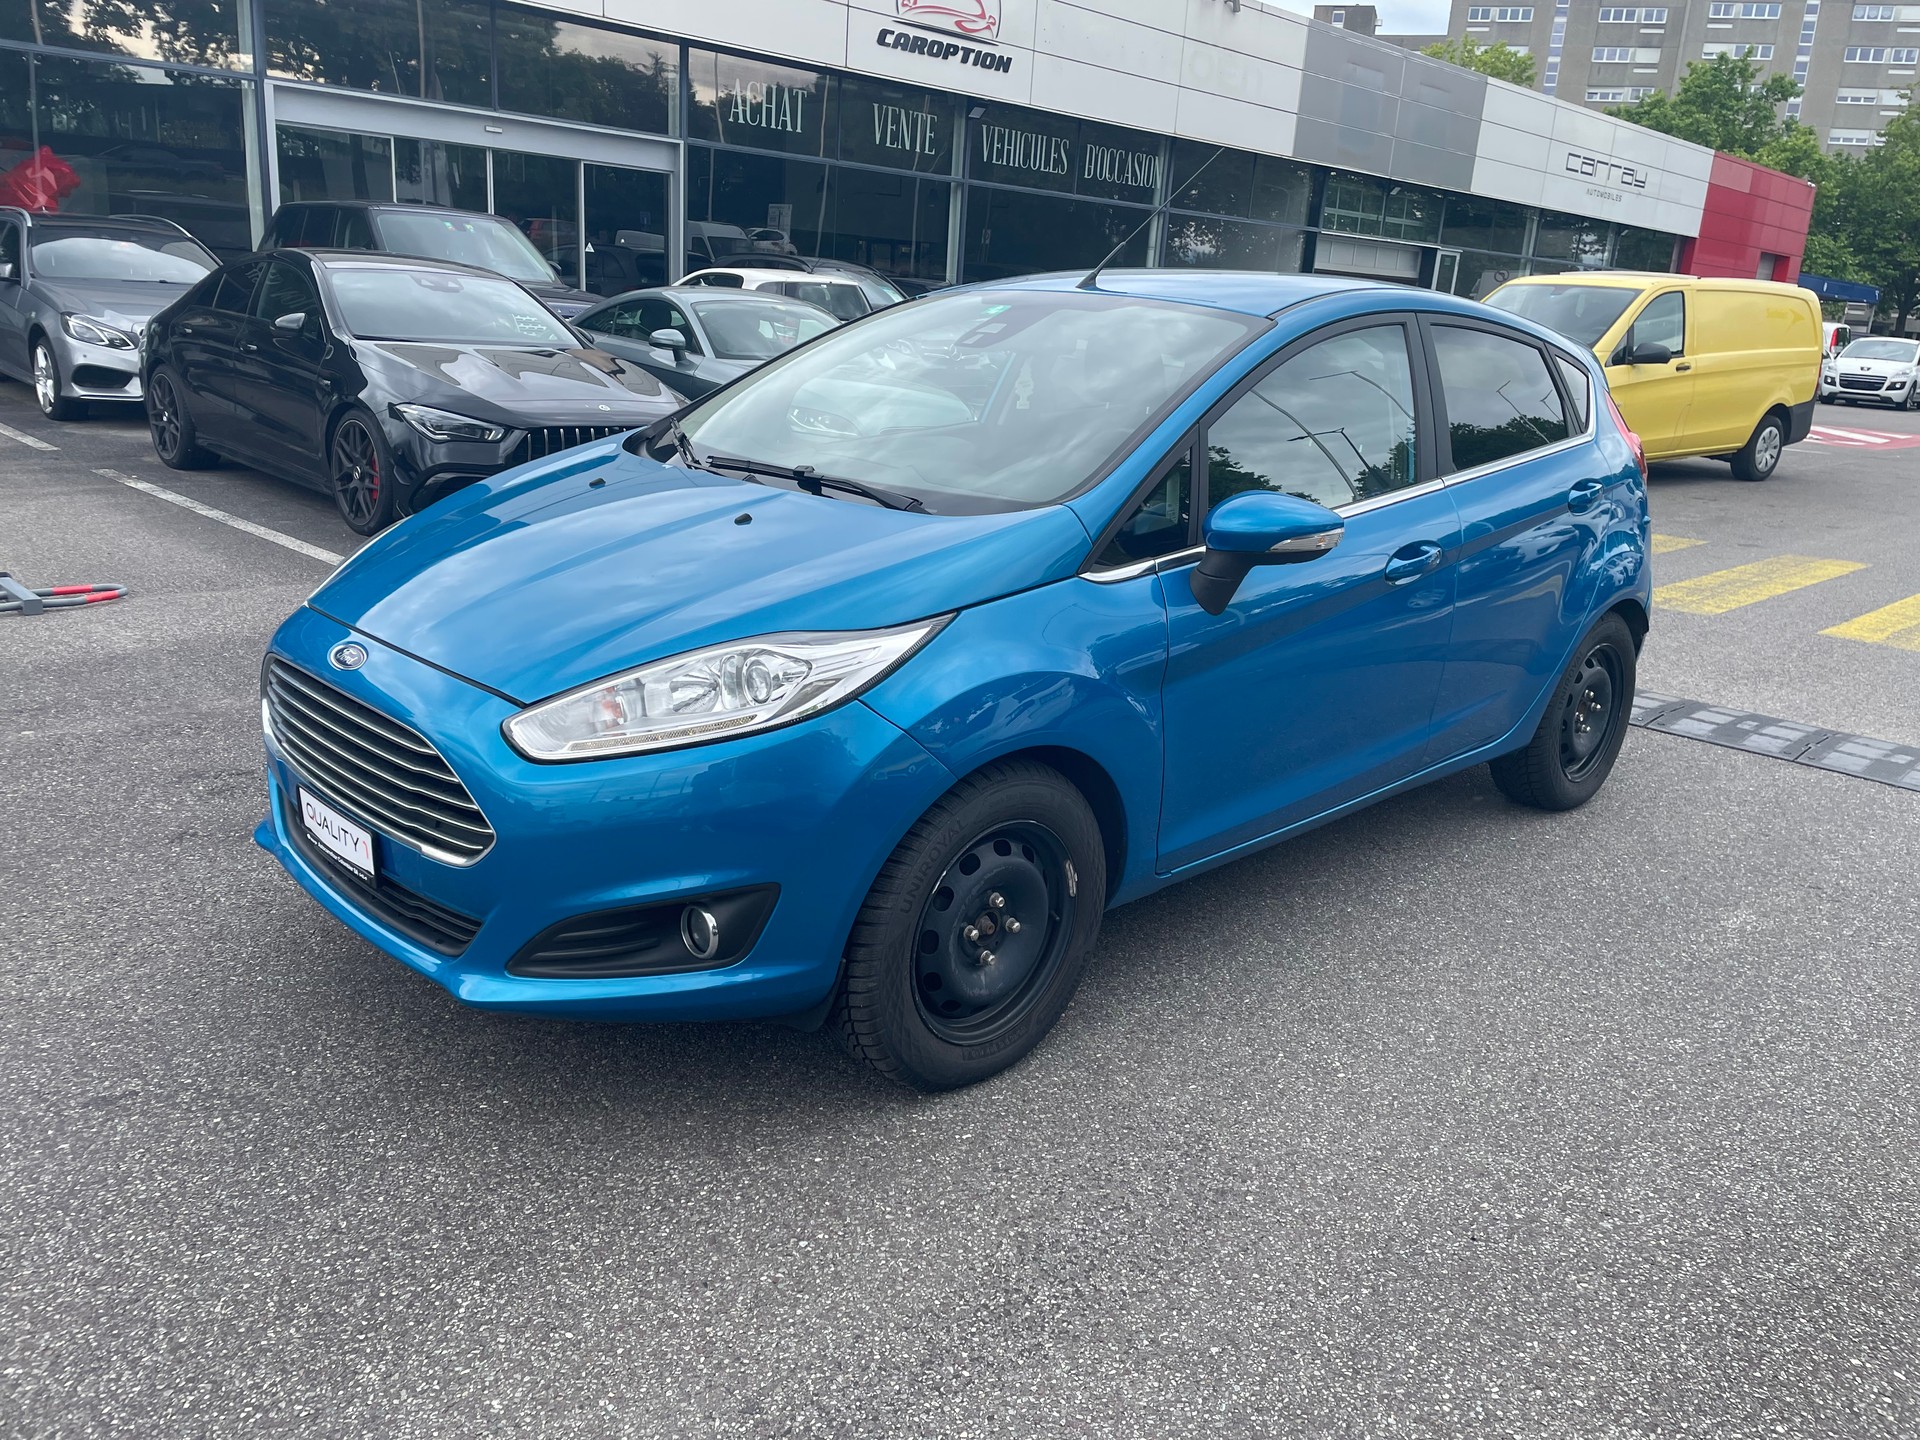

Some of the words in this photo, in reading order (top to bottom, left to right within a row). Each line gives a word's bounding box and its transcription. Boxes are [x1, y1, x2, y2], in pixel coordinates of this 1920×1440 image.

[877, 28, 1013, 74] CAROPTION
[728, 78, 808, 134] ACHAT
[873, 103, 938, 156] VENTE
[981, 124, 1070, 175] VEHICULES
[1084, 144, 1164, 189] D'OCCASION
[1565, 152, 1648, 189] carray
[1586, 187, 1623, 203] AUTOMOBILES
[336, 648, 358, 665] Ford
[306, 802, 360, 853] QUALITY
[363, 840, 370, 860] 1
[900, 816, 968, 914] UNIROYAL
